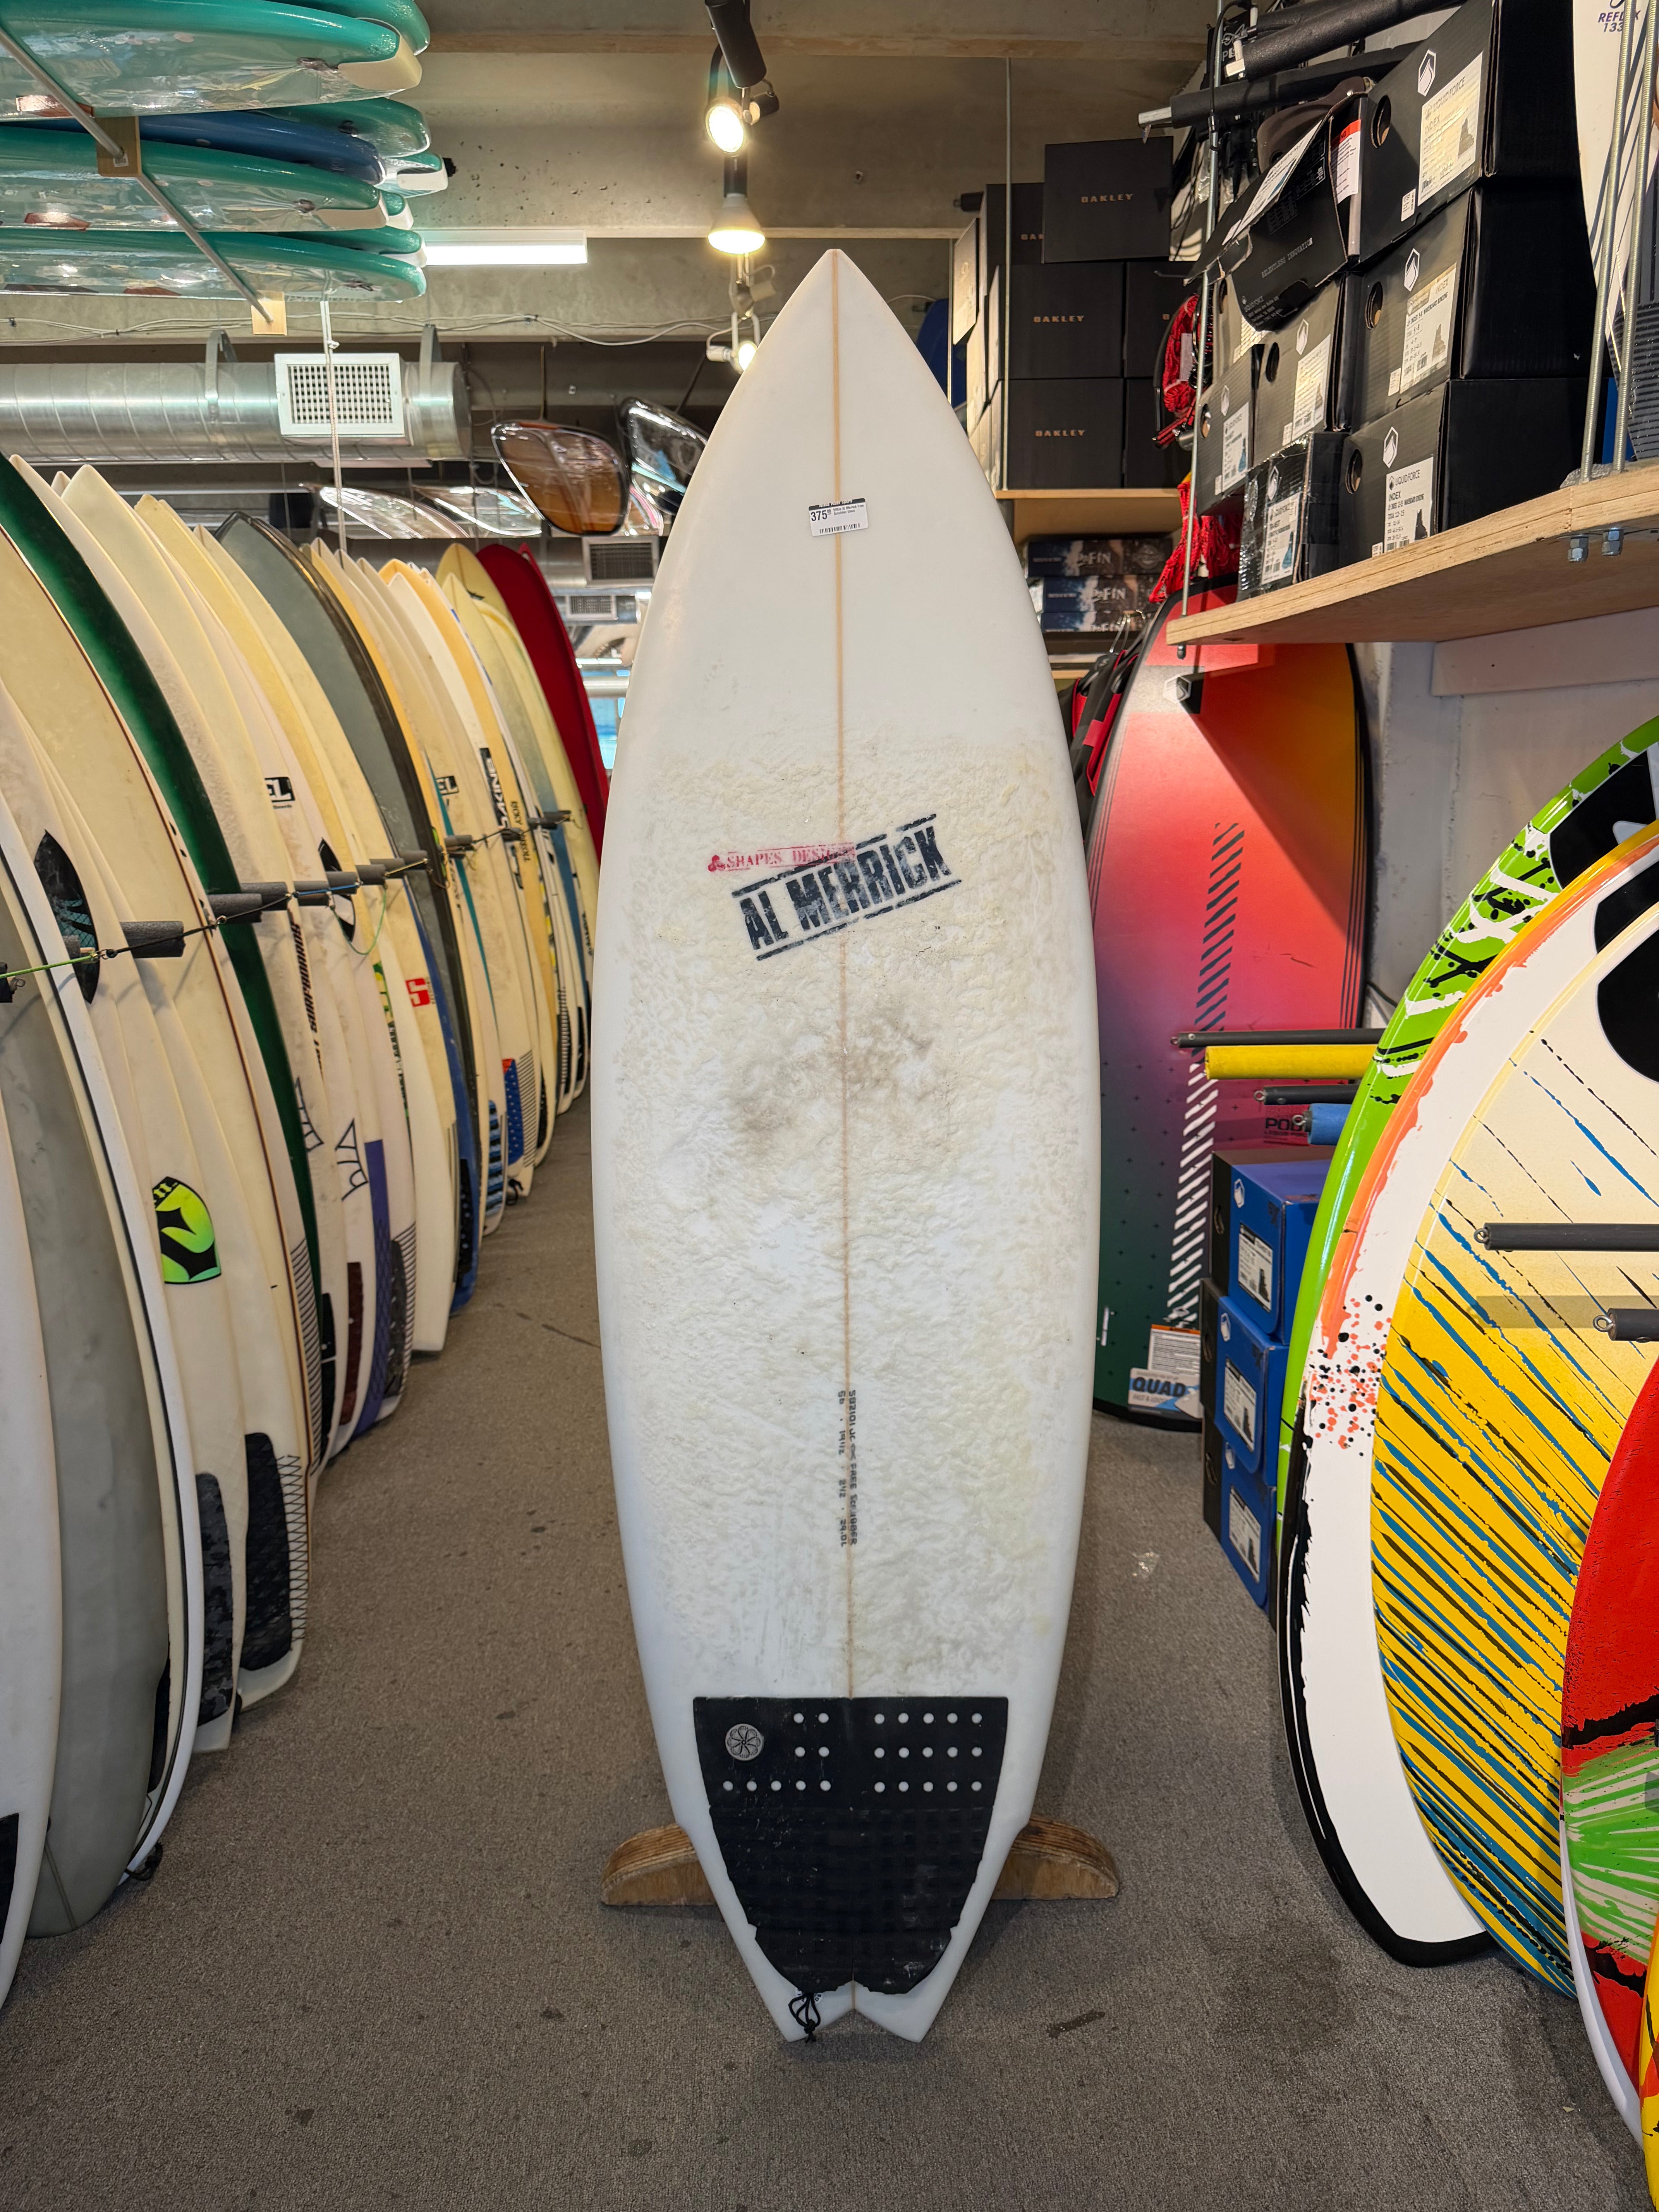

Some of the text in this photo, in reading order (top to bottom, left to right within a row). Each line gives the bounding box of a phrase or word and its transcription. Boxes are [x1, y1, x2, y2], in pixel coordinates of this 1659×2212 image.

[1598, 10, 1641, 22] REFLX
[1081, 194, 1133, 203] OAKLEY
[811, 510, 827, 521] 375
[727, 852, 782, 868] SHAPES
[739, 826, 951, 950] AL MERRICK
[1133, 1377, 1186, 1397] QUAD
